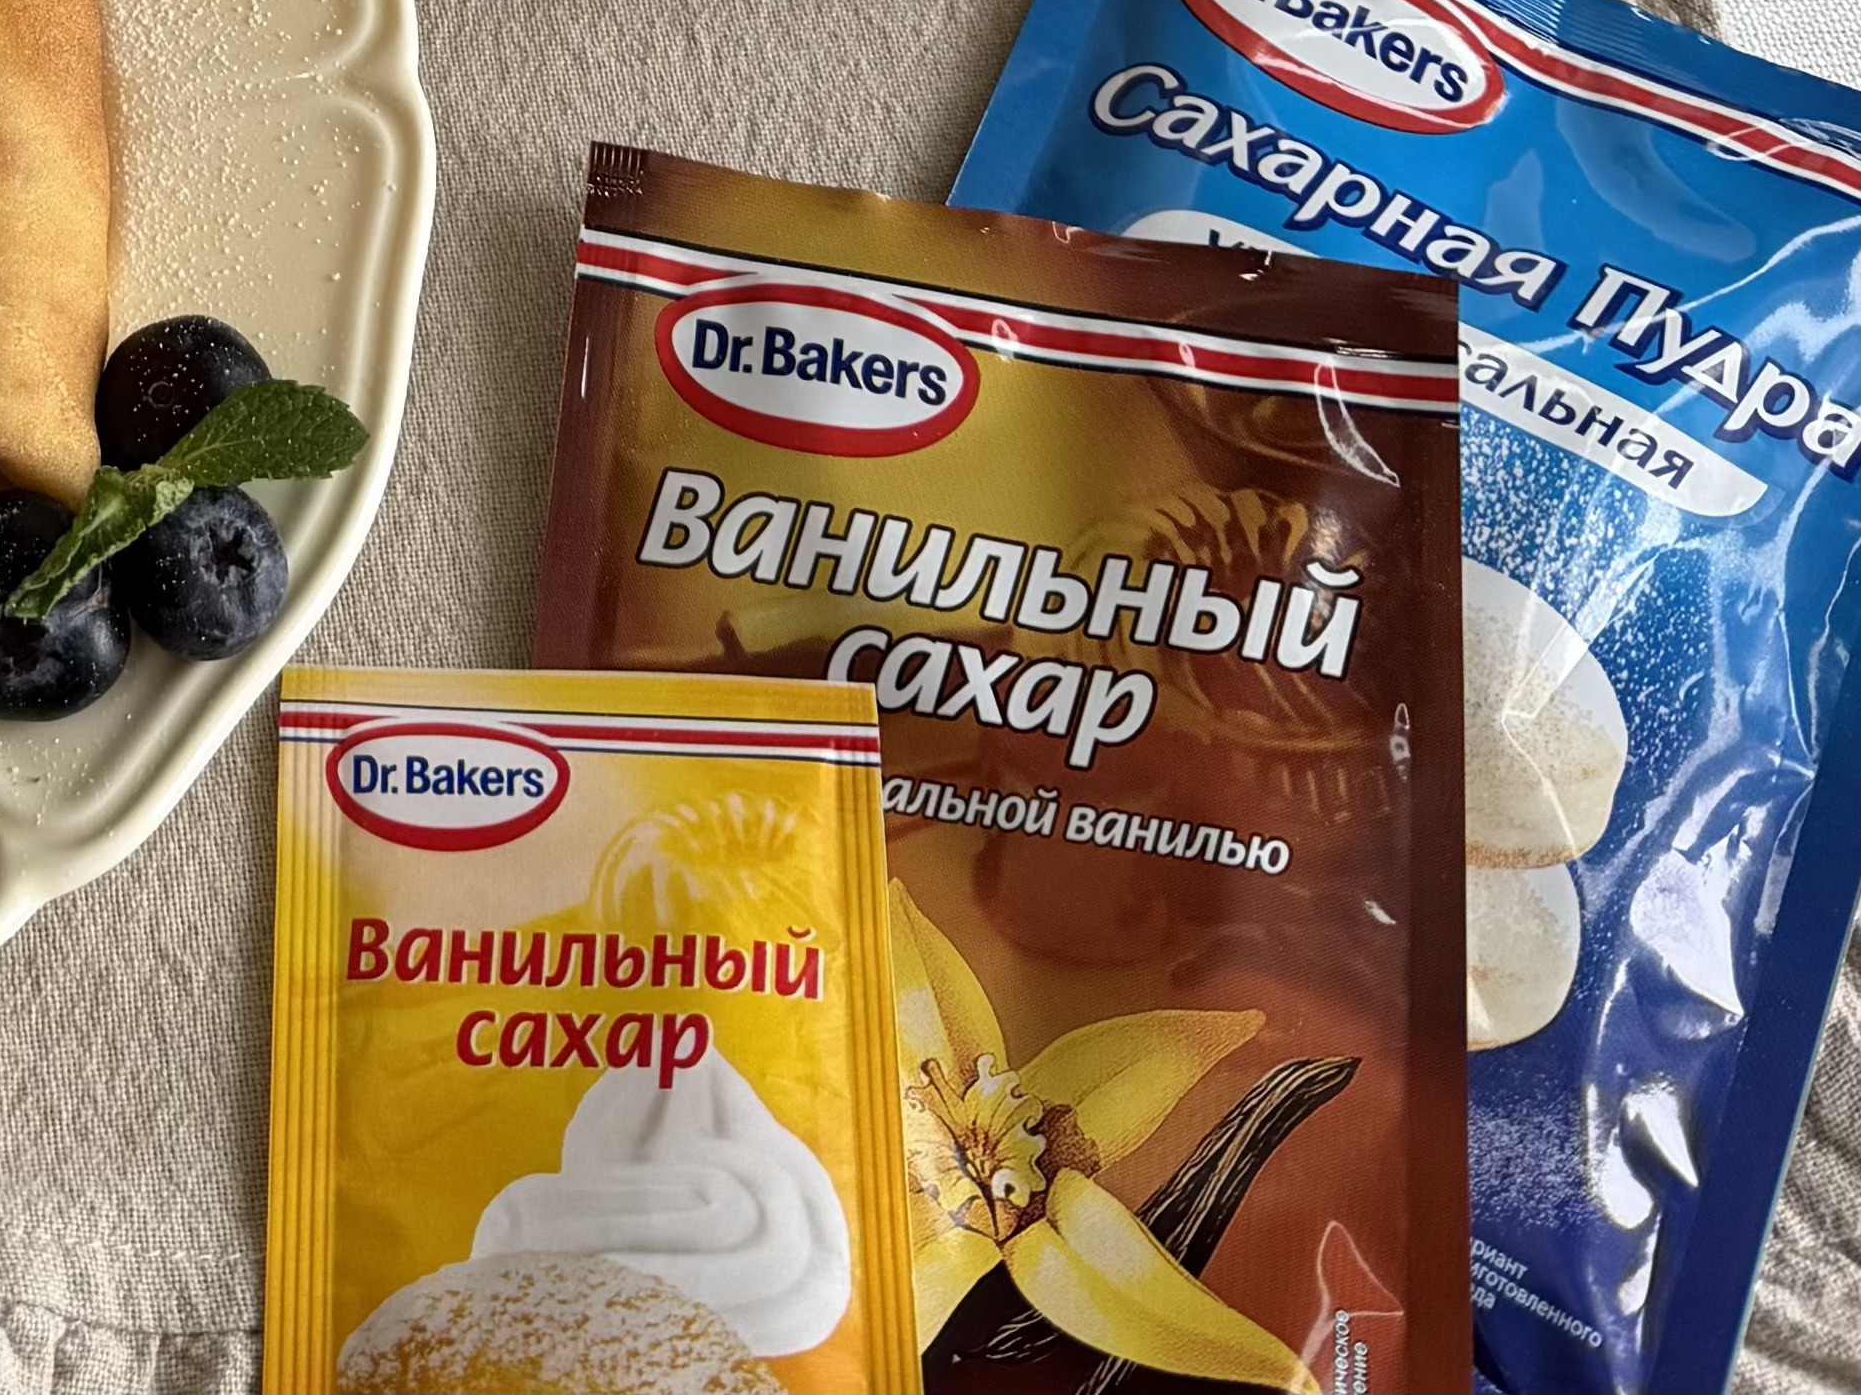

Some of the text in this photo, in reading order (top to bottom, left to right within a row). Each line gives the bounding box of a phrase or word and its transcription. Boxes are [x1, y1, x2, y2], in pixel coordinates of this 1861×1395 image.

[1091, 64, 1861, 472] Сахарная Пудра
[1459, 340, 1696, 491] альная
[638, 467, 1364, 680] Ванильный
[825, 624, 1157, 770] сахар
[881, 775, 1292, 876] альной ванилью
[344, 917, 826, 1001] Ванильный
[455, 1009, 711, 1090] сахар
[1470, 1236, 1528, 1280] риант
[1470, 1260, 1603, 1348] иготовленного
[1334, 1309, 1350, 1395] ическое
